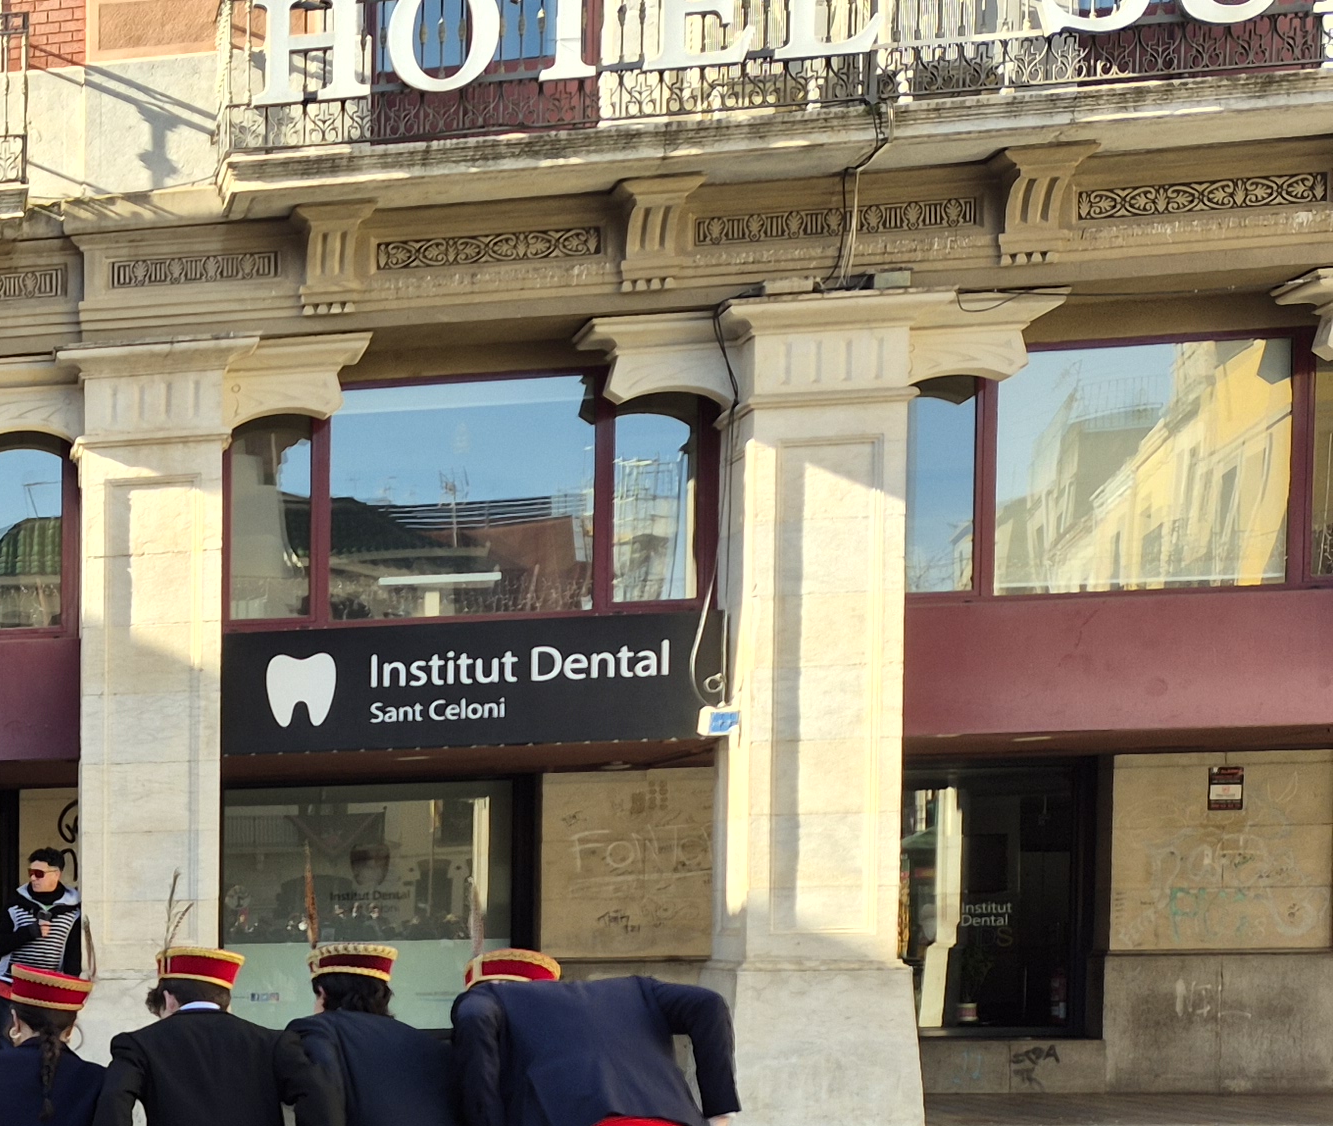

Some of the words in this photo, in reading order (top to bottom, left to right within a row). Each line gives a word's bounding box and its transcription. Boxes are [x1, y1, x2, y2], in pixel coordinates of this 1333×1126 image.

[368, 650, 519, 689] Institut
[530, 638, 671, 684] Dental
[369, 701, 424, 725] Sant
[428, 696, 507, 721] Celoni
[962, 902, 1013, 914] Institut
[961, 914, 1009, 927] Dental
